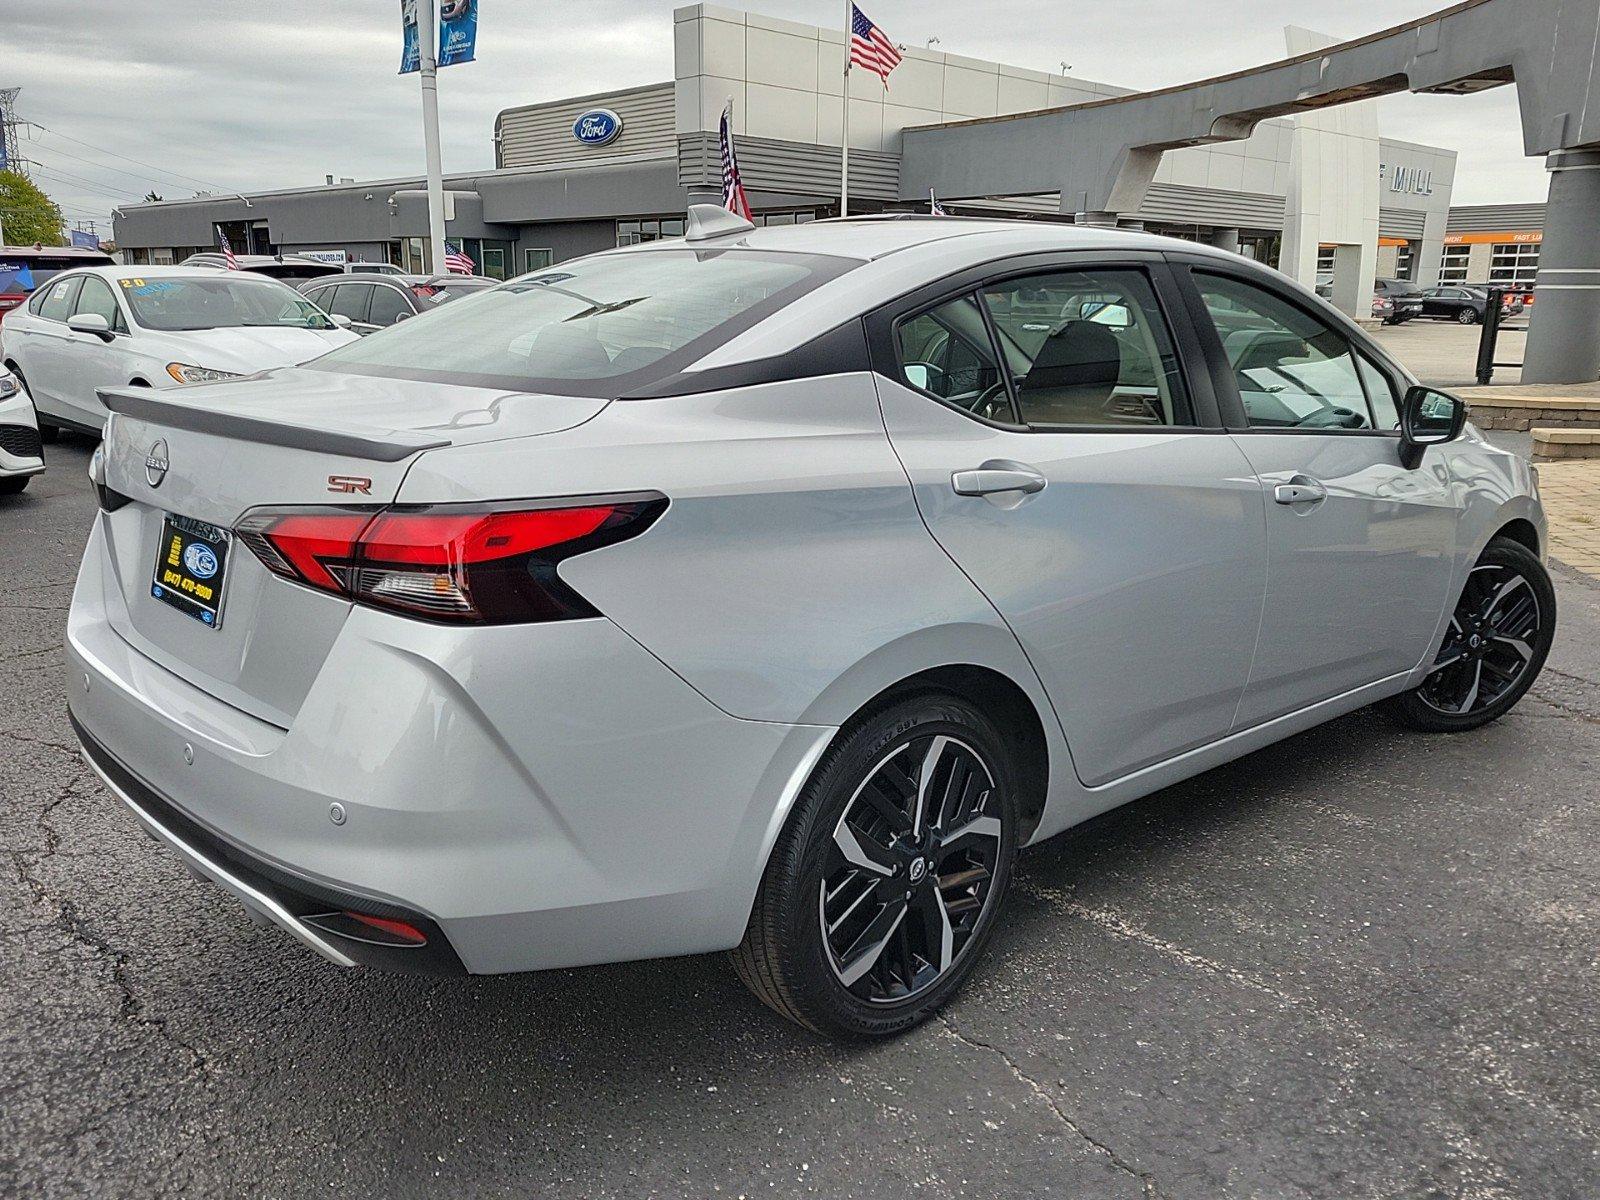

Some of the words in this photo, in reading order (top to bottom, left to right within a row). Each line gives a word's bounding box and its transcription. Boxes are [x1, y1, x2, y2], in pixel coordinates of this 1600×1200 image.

[580, 116, 607, 138] Ford
[1393, 166, 1433, 195] MILL
[327, 475, 372, 496] SR
